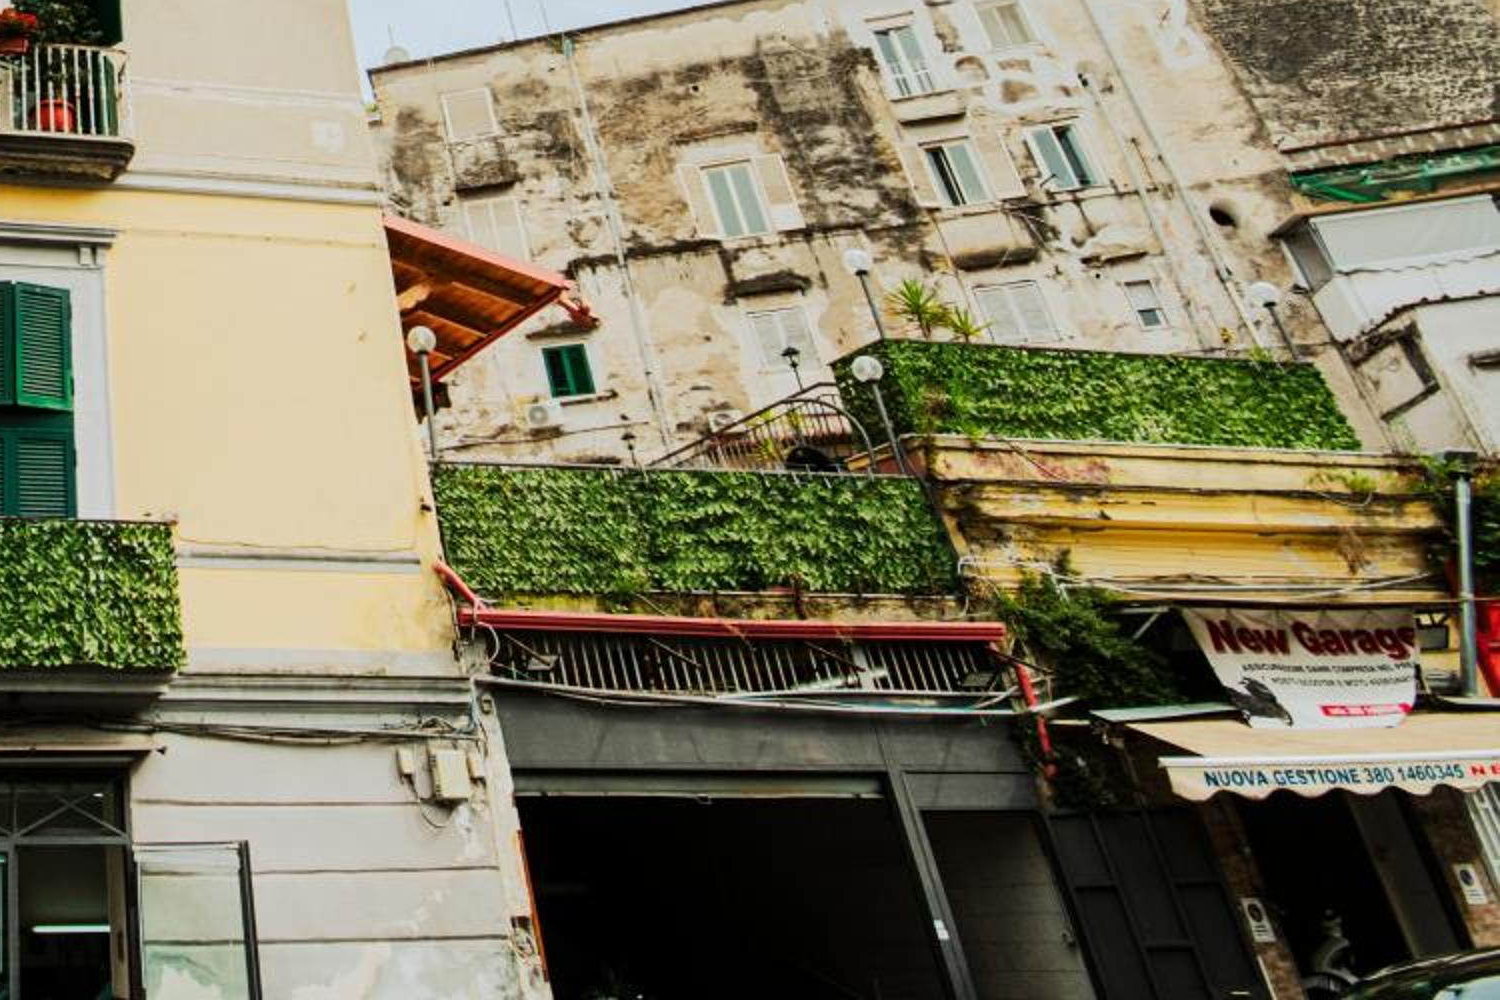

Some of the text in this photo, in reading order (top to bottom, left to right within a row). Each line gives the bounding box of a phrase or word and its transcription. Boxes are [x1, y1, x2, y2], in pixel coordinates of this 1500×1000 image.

[1205, 618, 1291, 656] New
[1203, 770, 1269, 787] NUOVA
[1273, 767, 1362, 786] GESTIONE
[1363, 767, 1395, 783] 380
[1397, 763, 1465, 781] 1460345
